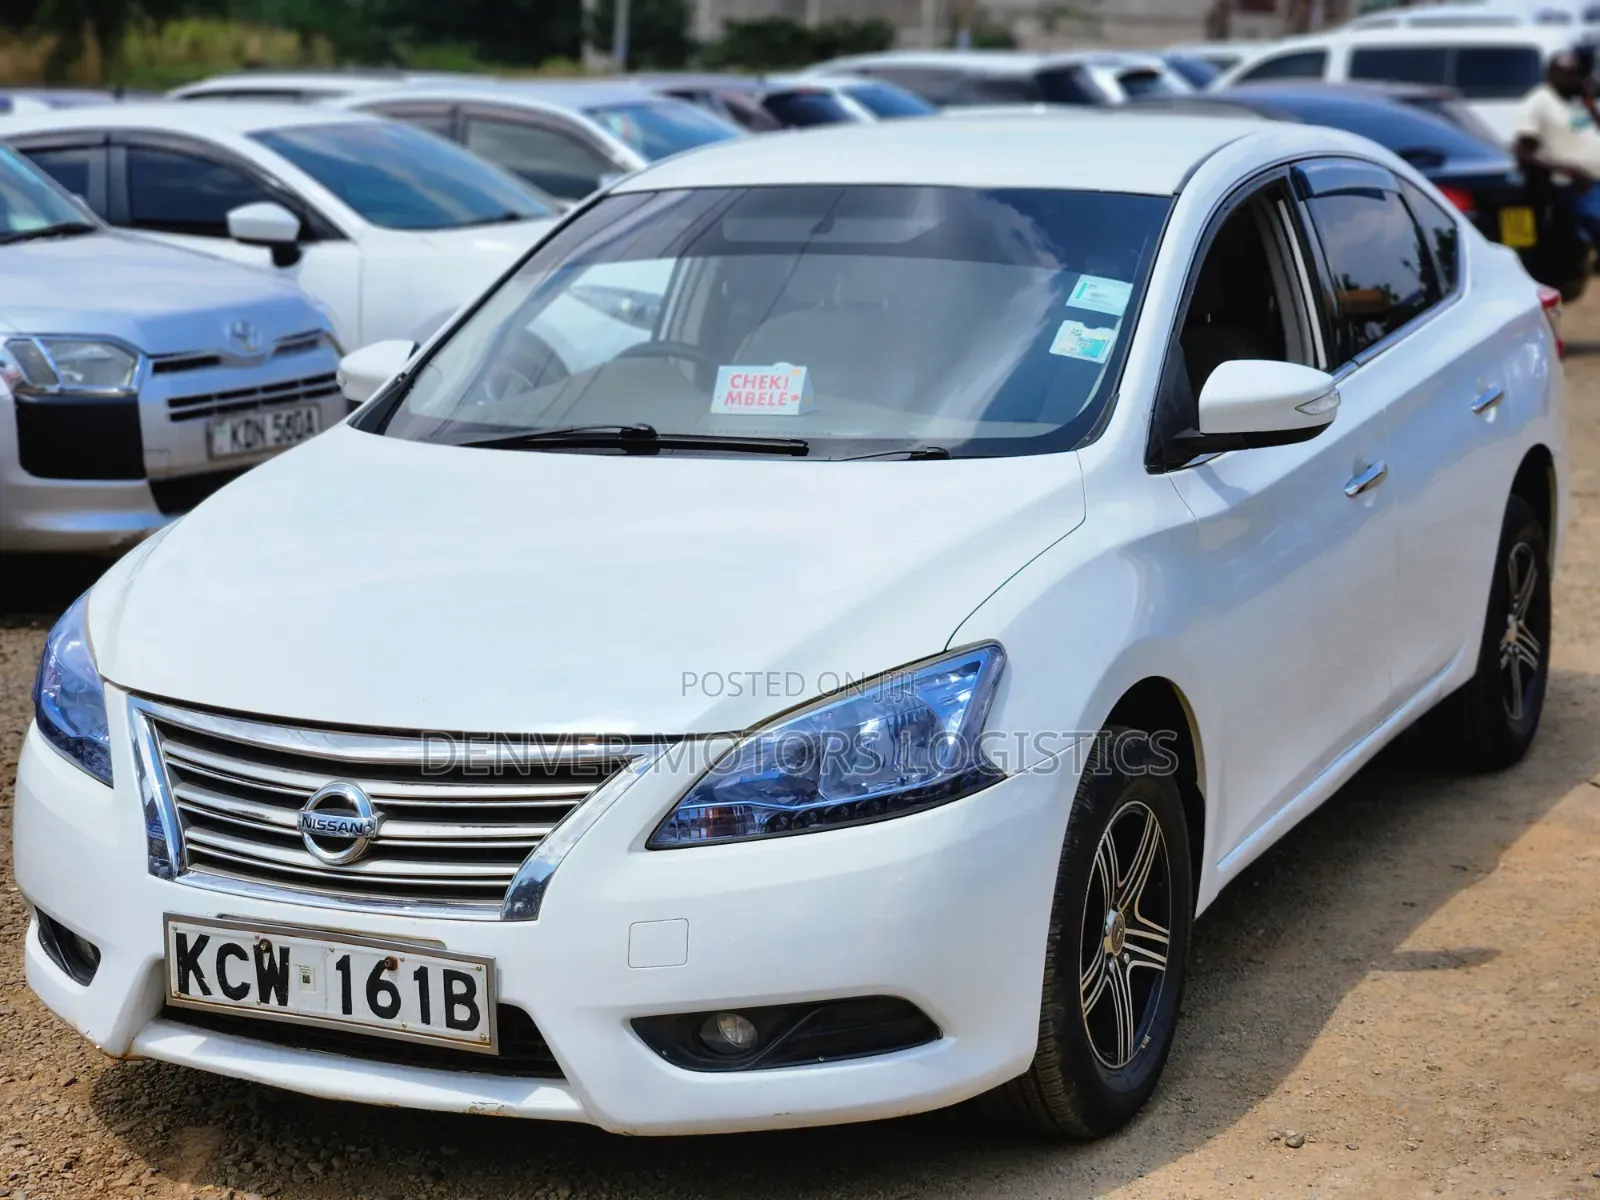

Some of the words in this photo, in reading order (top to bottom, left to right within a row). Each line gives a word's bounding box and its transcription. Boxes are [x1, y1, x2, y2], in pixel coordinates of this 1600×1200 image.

[730, 373, 789, 390] CHEKI
[723, 391, 788, 406] MBELE
[301, 815, 364, 834] NISSAN
[175, 932, 291, 1008] KCW
[335, 953, 481, 1032] 161B
